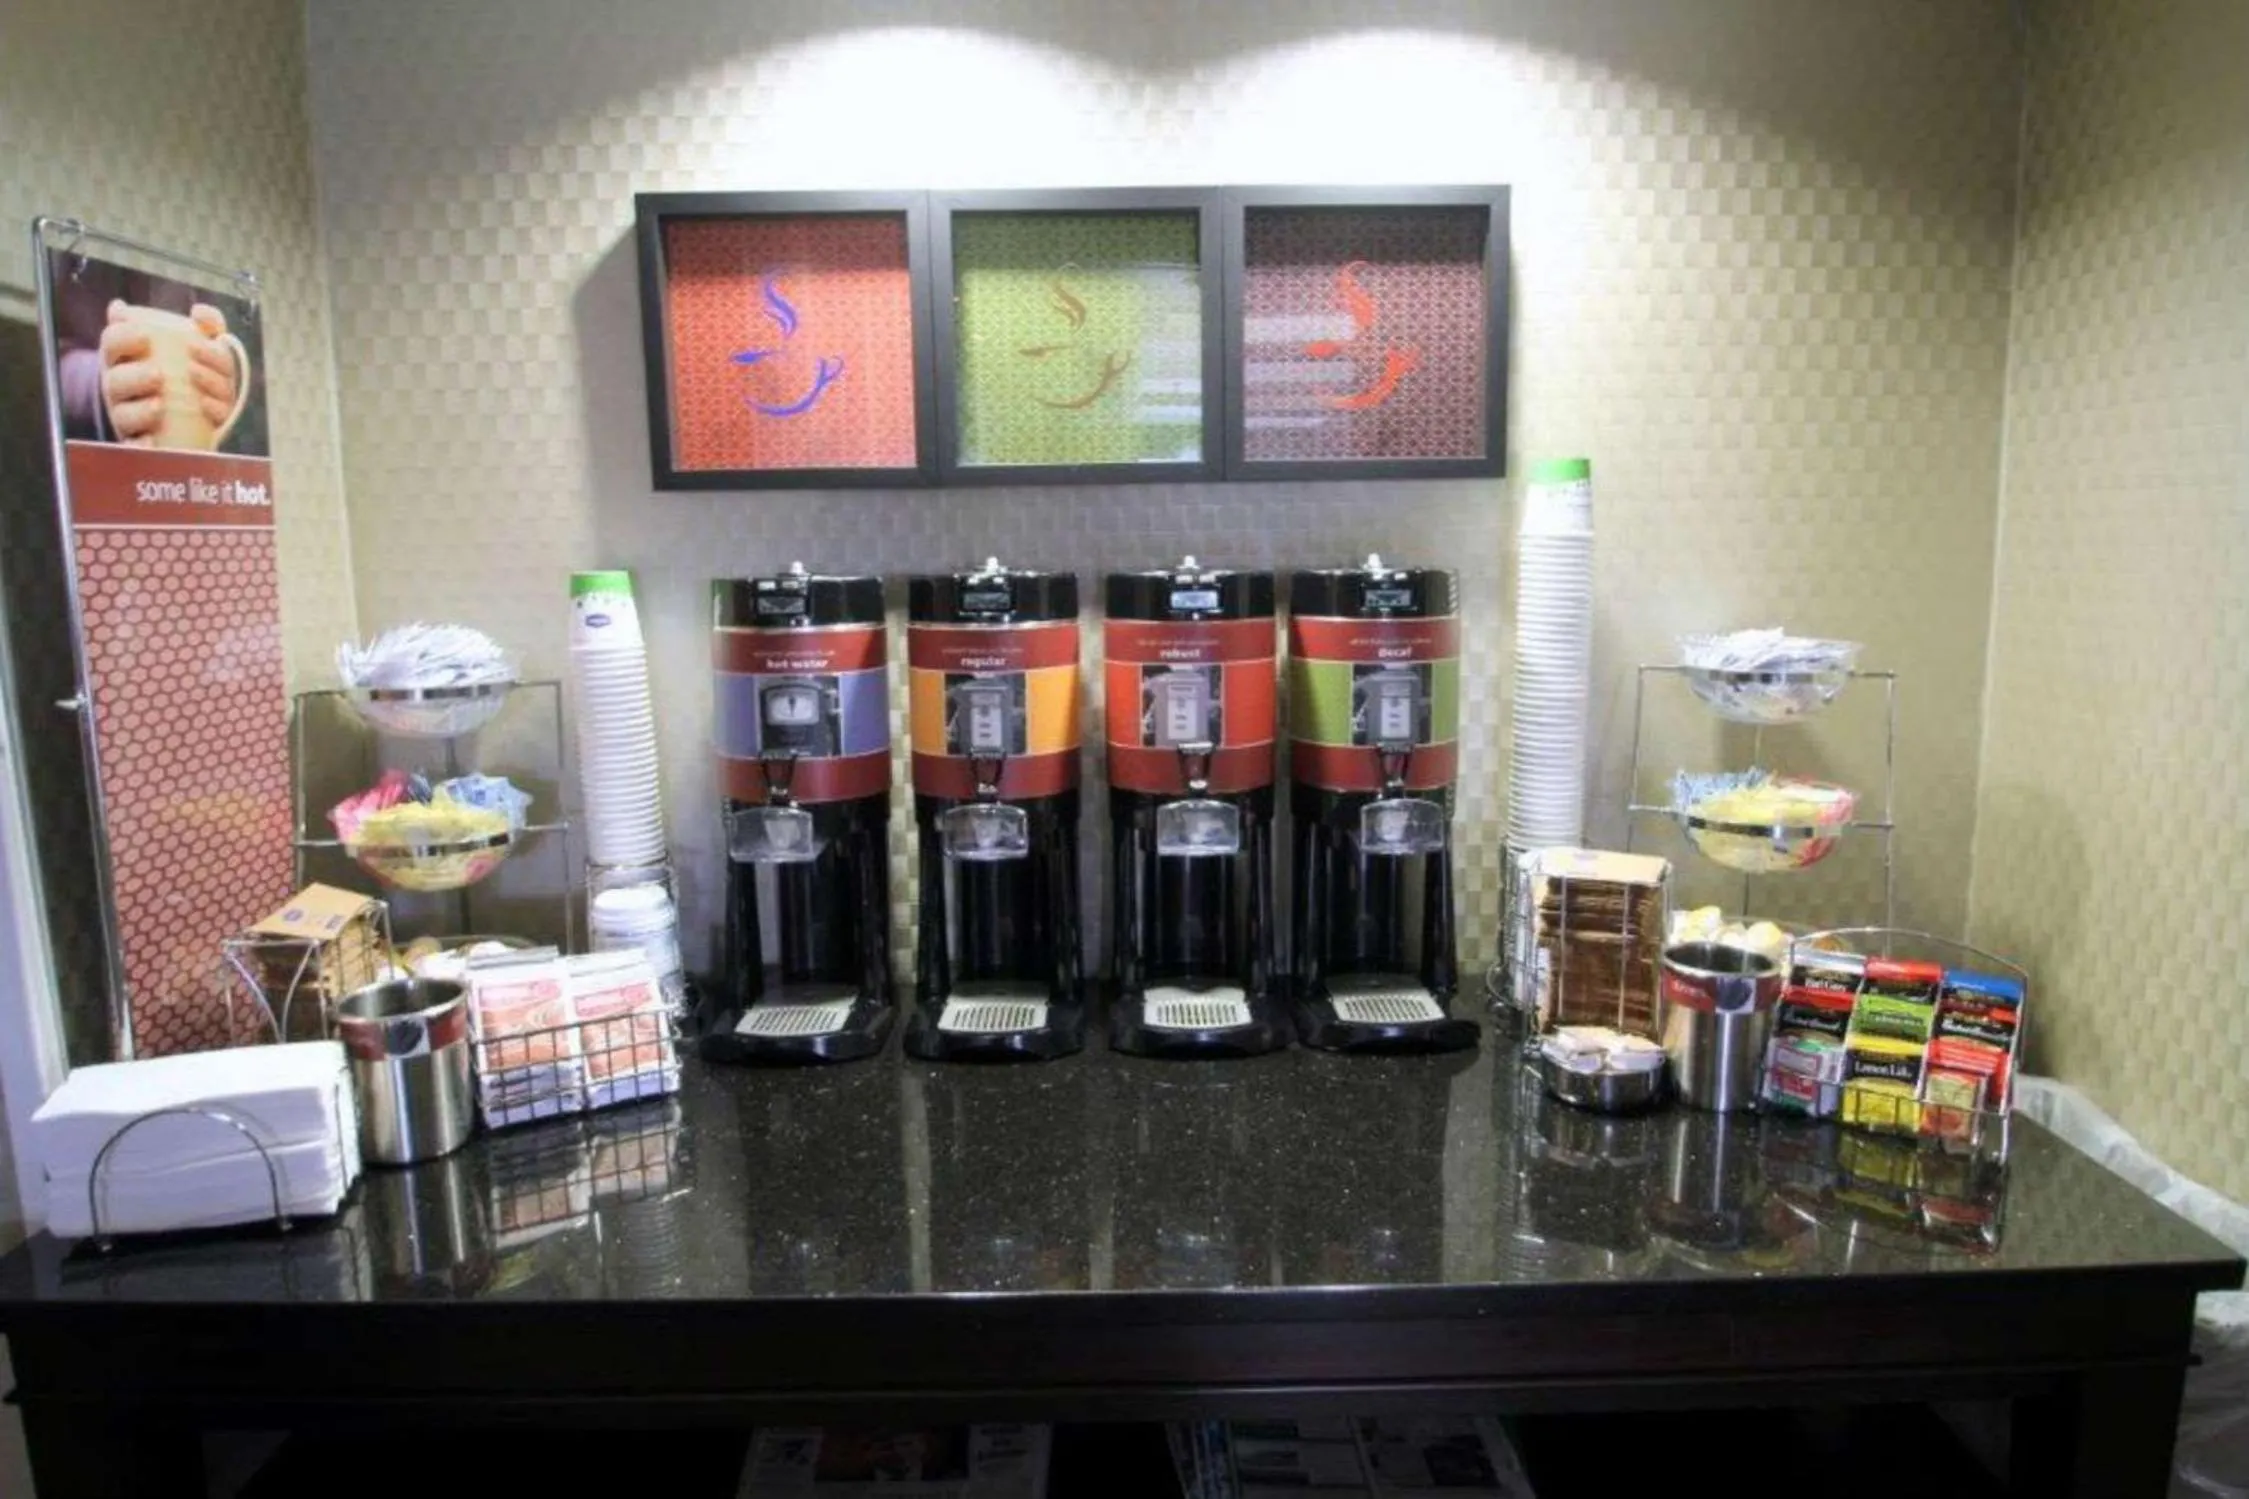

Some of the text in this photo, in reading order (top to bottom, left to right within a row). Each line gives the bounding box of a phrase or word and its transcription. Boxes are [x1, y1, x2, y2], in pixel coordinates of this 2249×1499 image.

[135, 476, 271, 505] some like it hot.
[1159, 648, 1200, 658] robust
[765, 658, 829, 670] hot water
[960, 656, 1006, 669] regular
